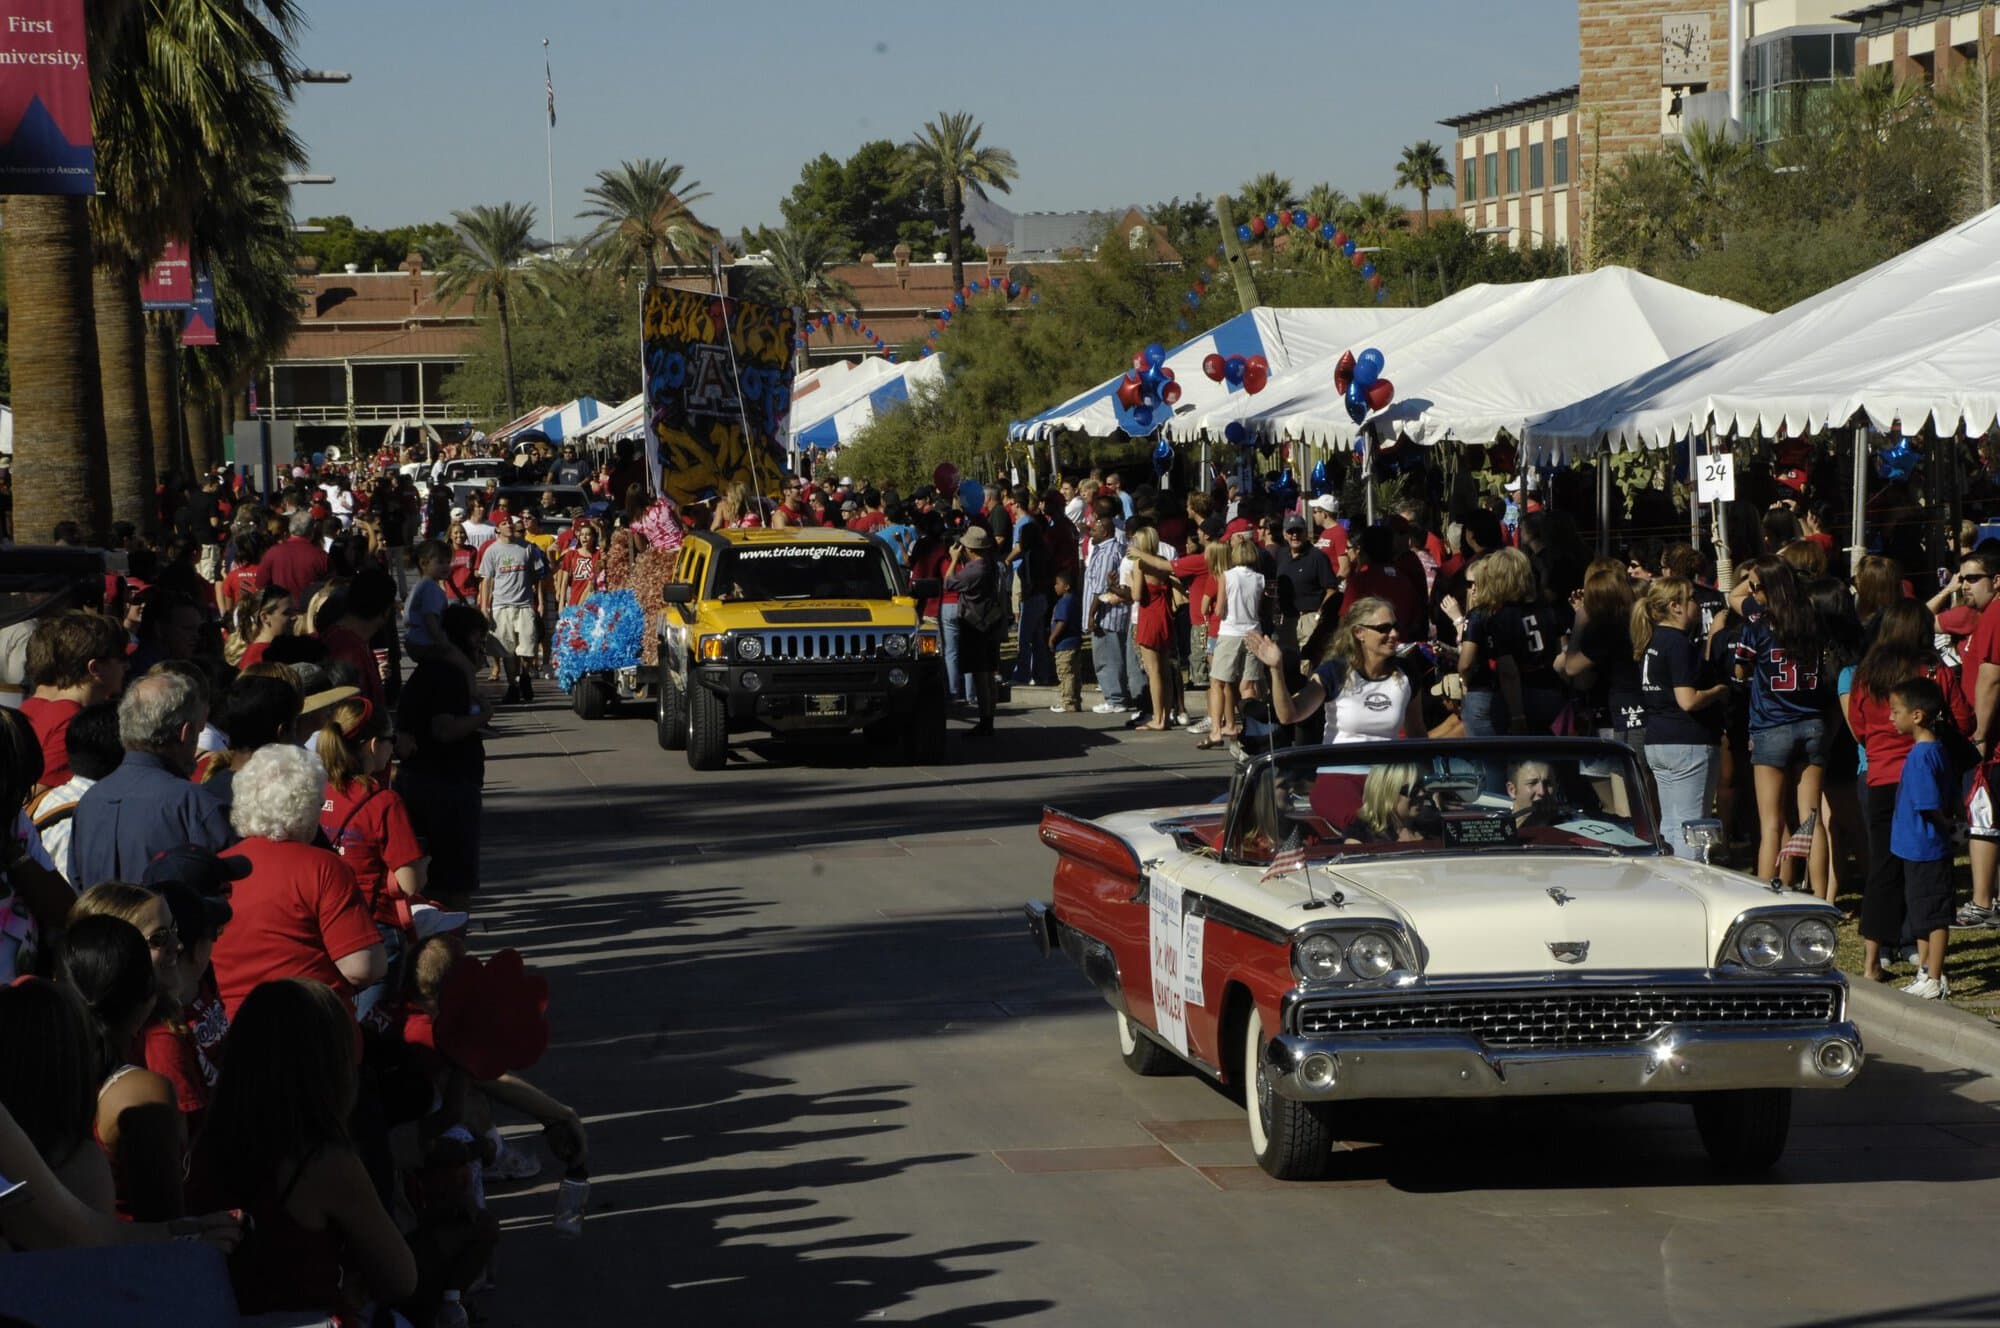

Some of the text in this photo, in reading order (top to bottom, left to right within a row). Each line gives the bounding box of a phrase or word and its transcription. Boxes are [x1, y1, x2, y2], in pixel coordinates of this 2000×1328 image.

[8, 16, 54, 33] First
[1705, 464, 1727, 482] 24
[739, 546, 866, 560] www.tridentgrill.com
